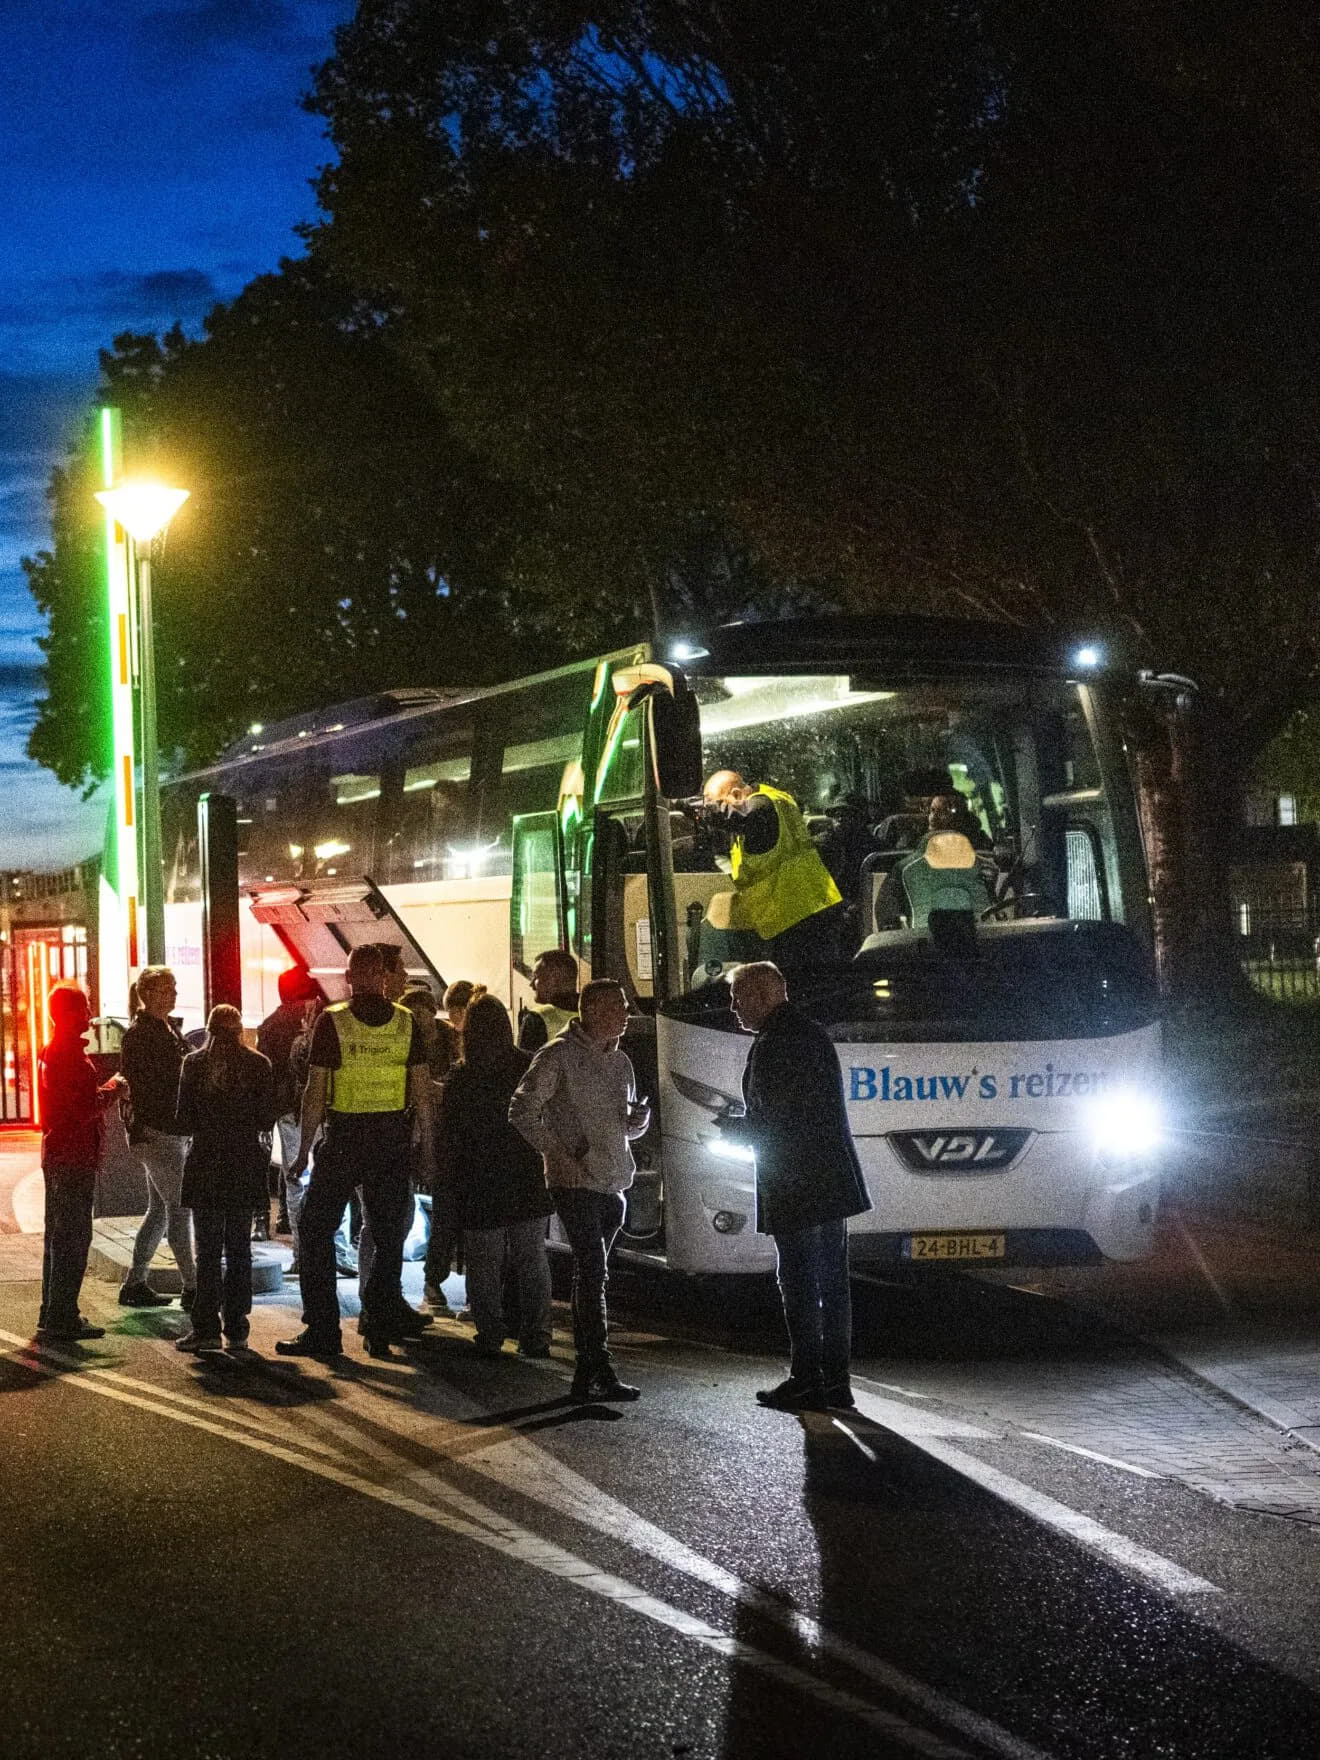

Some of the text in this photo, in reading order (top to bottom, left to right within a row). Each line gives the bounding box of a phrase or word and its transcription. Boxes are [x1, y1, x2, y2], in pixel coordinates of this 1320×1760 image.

[849, 1066, 998, 1102] Blauw's
[912, 1136, 1007, 1160] VDL
[917, 1239, 999, 1257] 24-BHL-4
